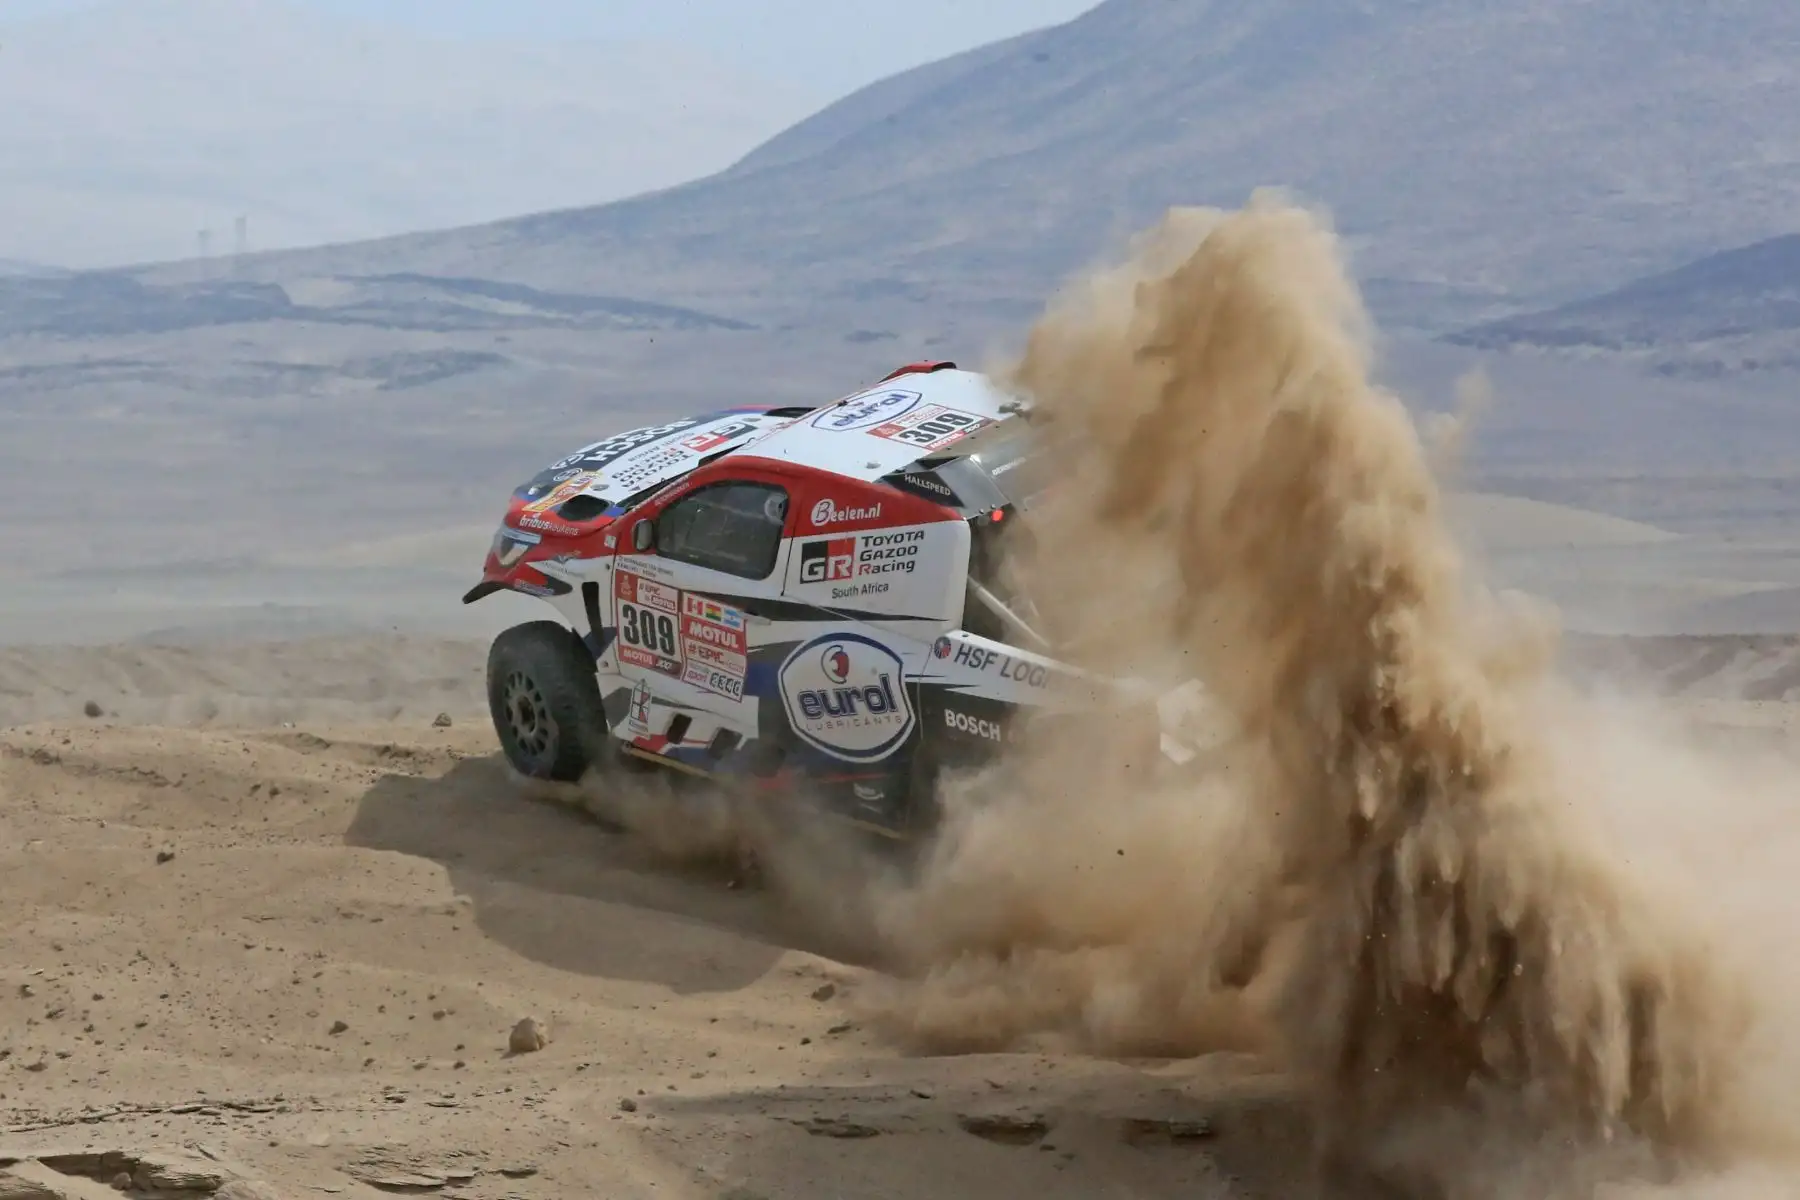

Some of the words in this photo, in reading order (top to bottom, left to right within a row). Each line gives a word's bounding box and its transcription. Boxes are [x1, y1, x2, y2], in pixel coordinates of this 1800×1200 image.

[833, 393, 909, 428] eurol
[899, 413, 975, 443] 309
[620, 454, 694, 488] TOYOTA
[904, 473, 951, 496] HALLSPEED
[812, 500, 881, 525] Beelen.nl
[861, 530, 925, 547] TOYOTA
[859, 545, 918, 562] GAZOO
[801, 554, 853, 582] GR
[858, 560, 916, 576] Racing
[831, 584, 859, 599] South
[861, 582, 889, 596] Africa
[622, 604, 675, 656] 309
[688, 621, 739, 648] MOTUL
[623, 647, 653, 665] MOTUL
[954, 643, 998, 671] HSF
[798, 673, 899, 720] eurol
[805, 716, 902, 732] LUBRICANTS
[944, 708, 1001, 742] BOSCH
